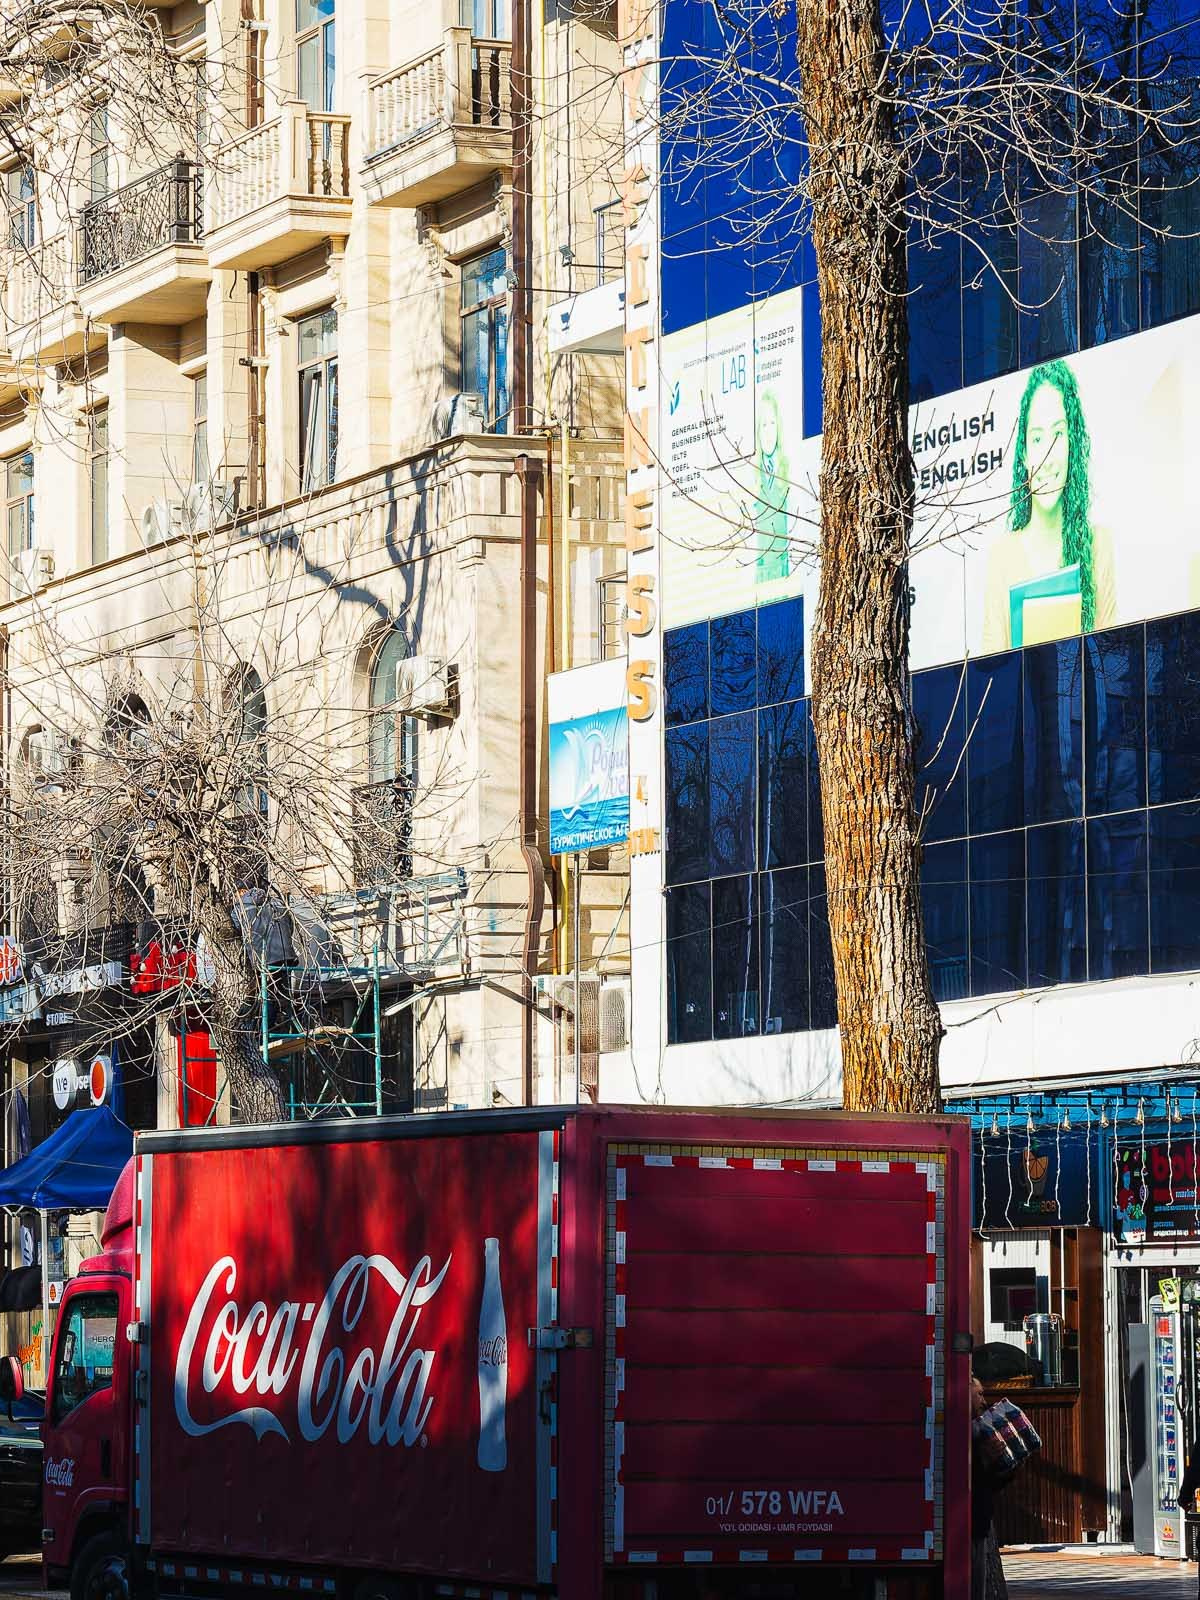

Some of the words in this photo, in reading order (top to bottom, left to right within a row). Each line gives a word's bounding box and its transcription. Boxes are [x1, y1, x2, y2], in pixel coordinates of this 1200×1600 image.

[722, 354, 746, 394] LAB
[672, 423, 698, 437] GENERAL
[700, 415, 724, 428] ENGLISH
[672, 435, 701, 450] BUSINESS
[702, 426, 726, 440] ENGLISH
[912, 412, 994, 454] ENGLISH
[622, 164, 659, 724] FITNESS
[672, 450, 687, 462] IELTS
[672, 463, 690, 474] TOEFL
[920, 448, 1003, 490] ENGLISH
[552, 825, 613, 851] ТУРИСТИЧЕСКОЕ
[46, 1012, 68, 1026] STORE
[174, 1252, 452, 1448] Coca-Cola
[741, 1490, 782, 1515] 578
[788, 1490, 844, 1515] WFA
[777, 1523, 796, 1532] UMR
